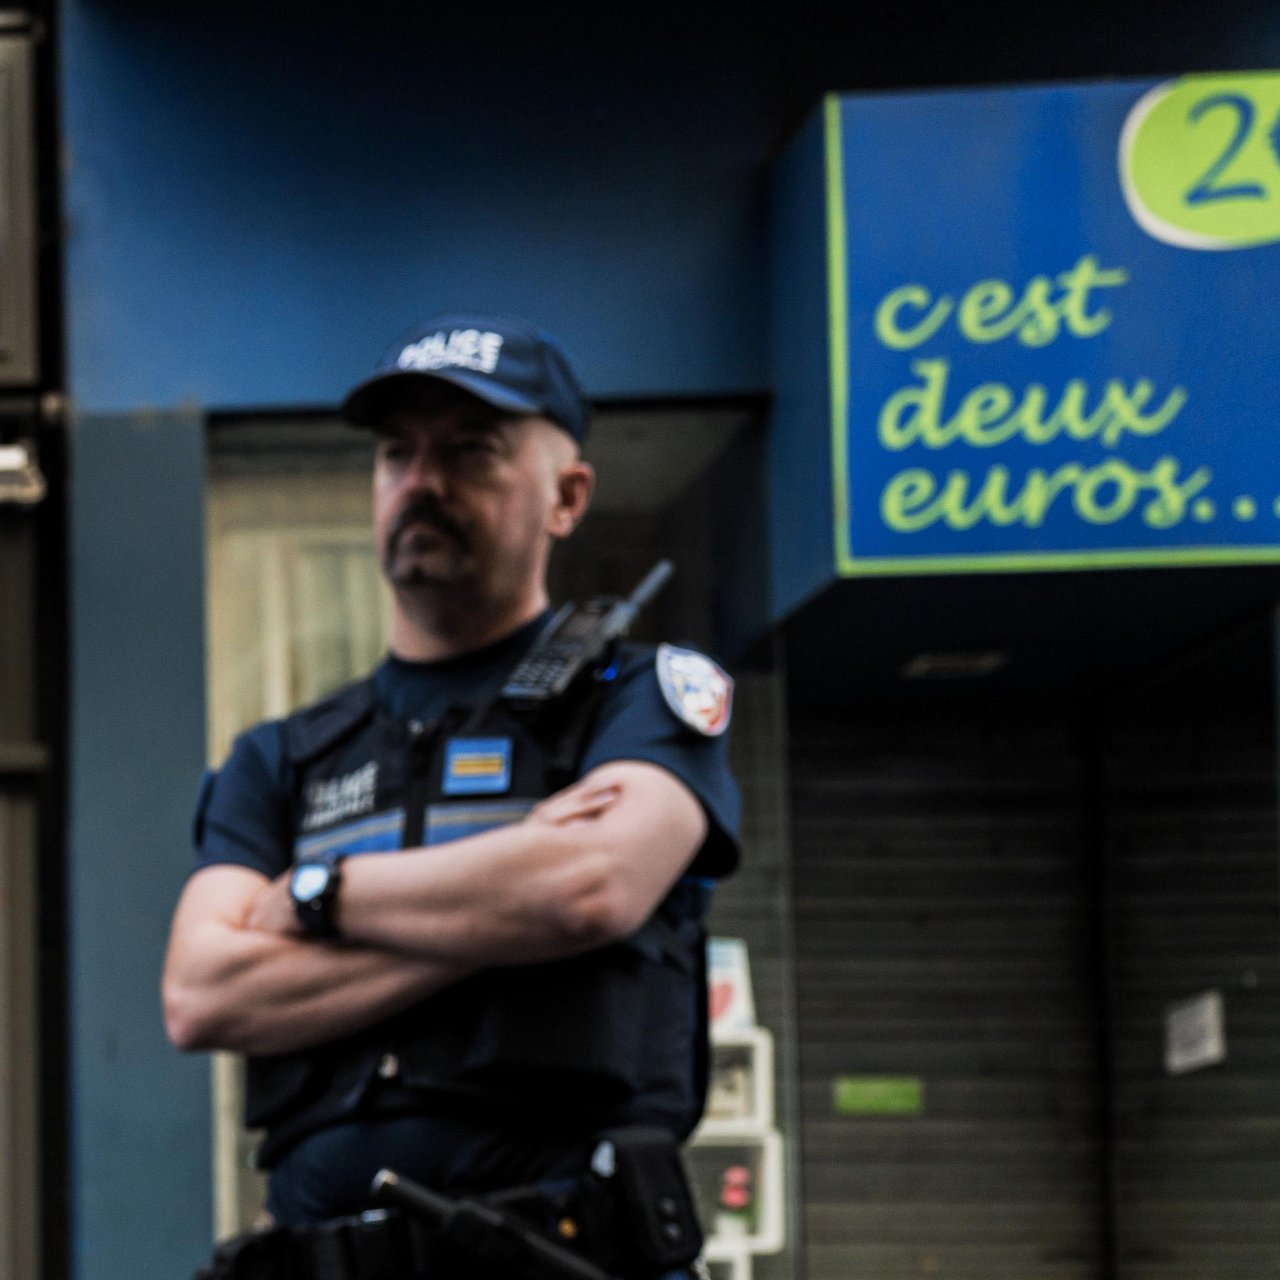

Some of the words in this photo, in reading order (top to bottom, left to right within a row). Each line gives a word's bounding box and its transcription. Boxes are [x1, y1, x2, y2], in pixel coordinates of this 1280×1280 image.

[1185, 89, 1280, 208] 2
[877, 357, 1187, 448] deux
[878, 454, 1280, 535] euros..
